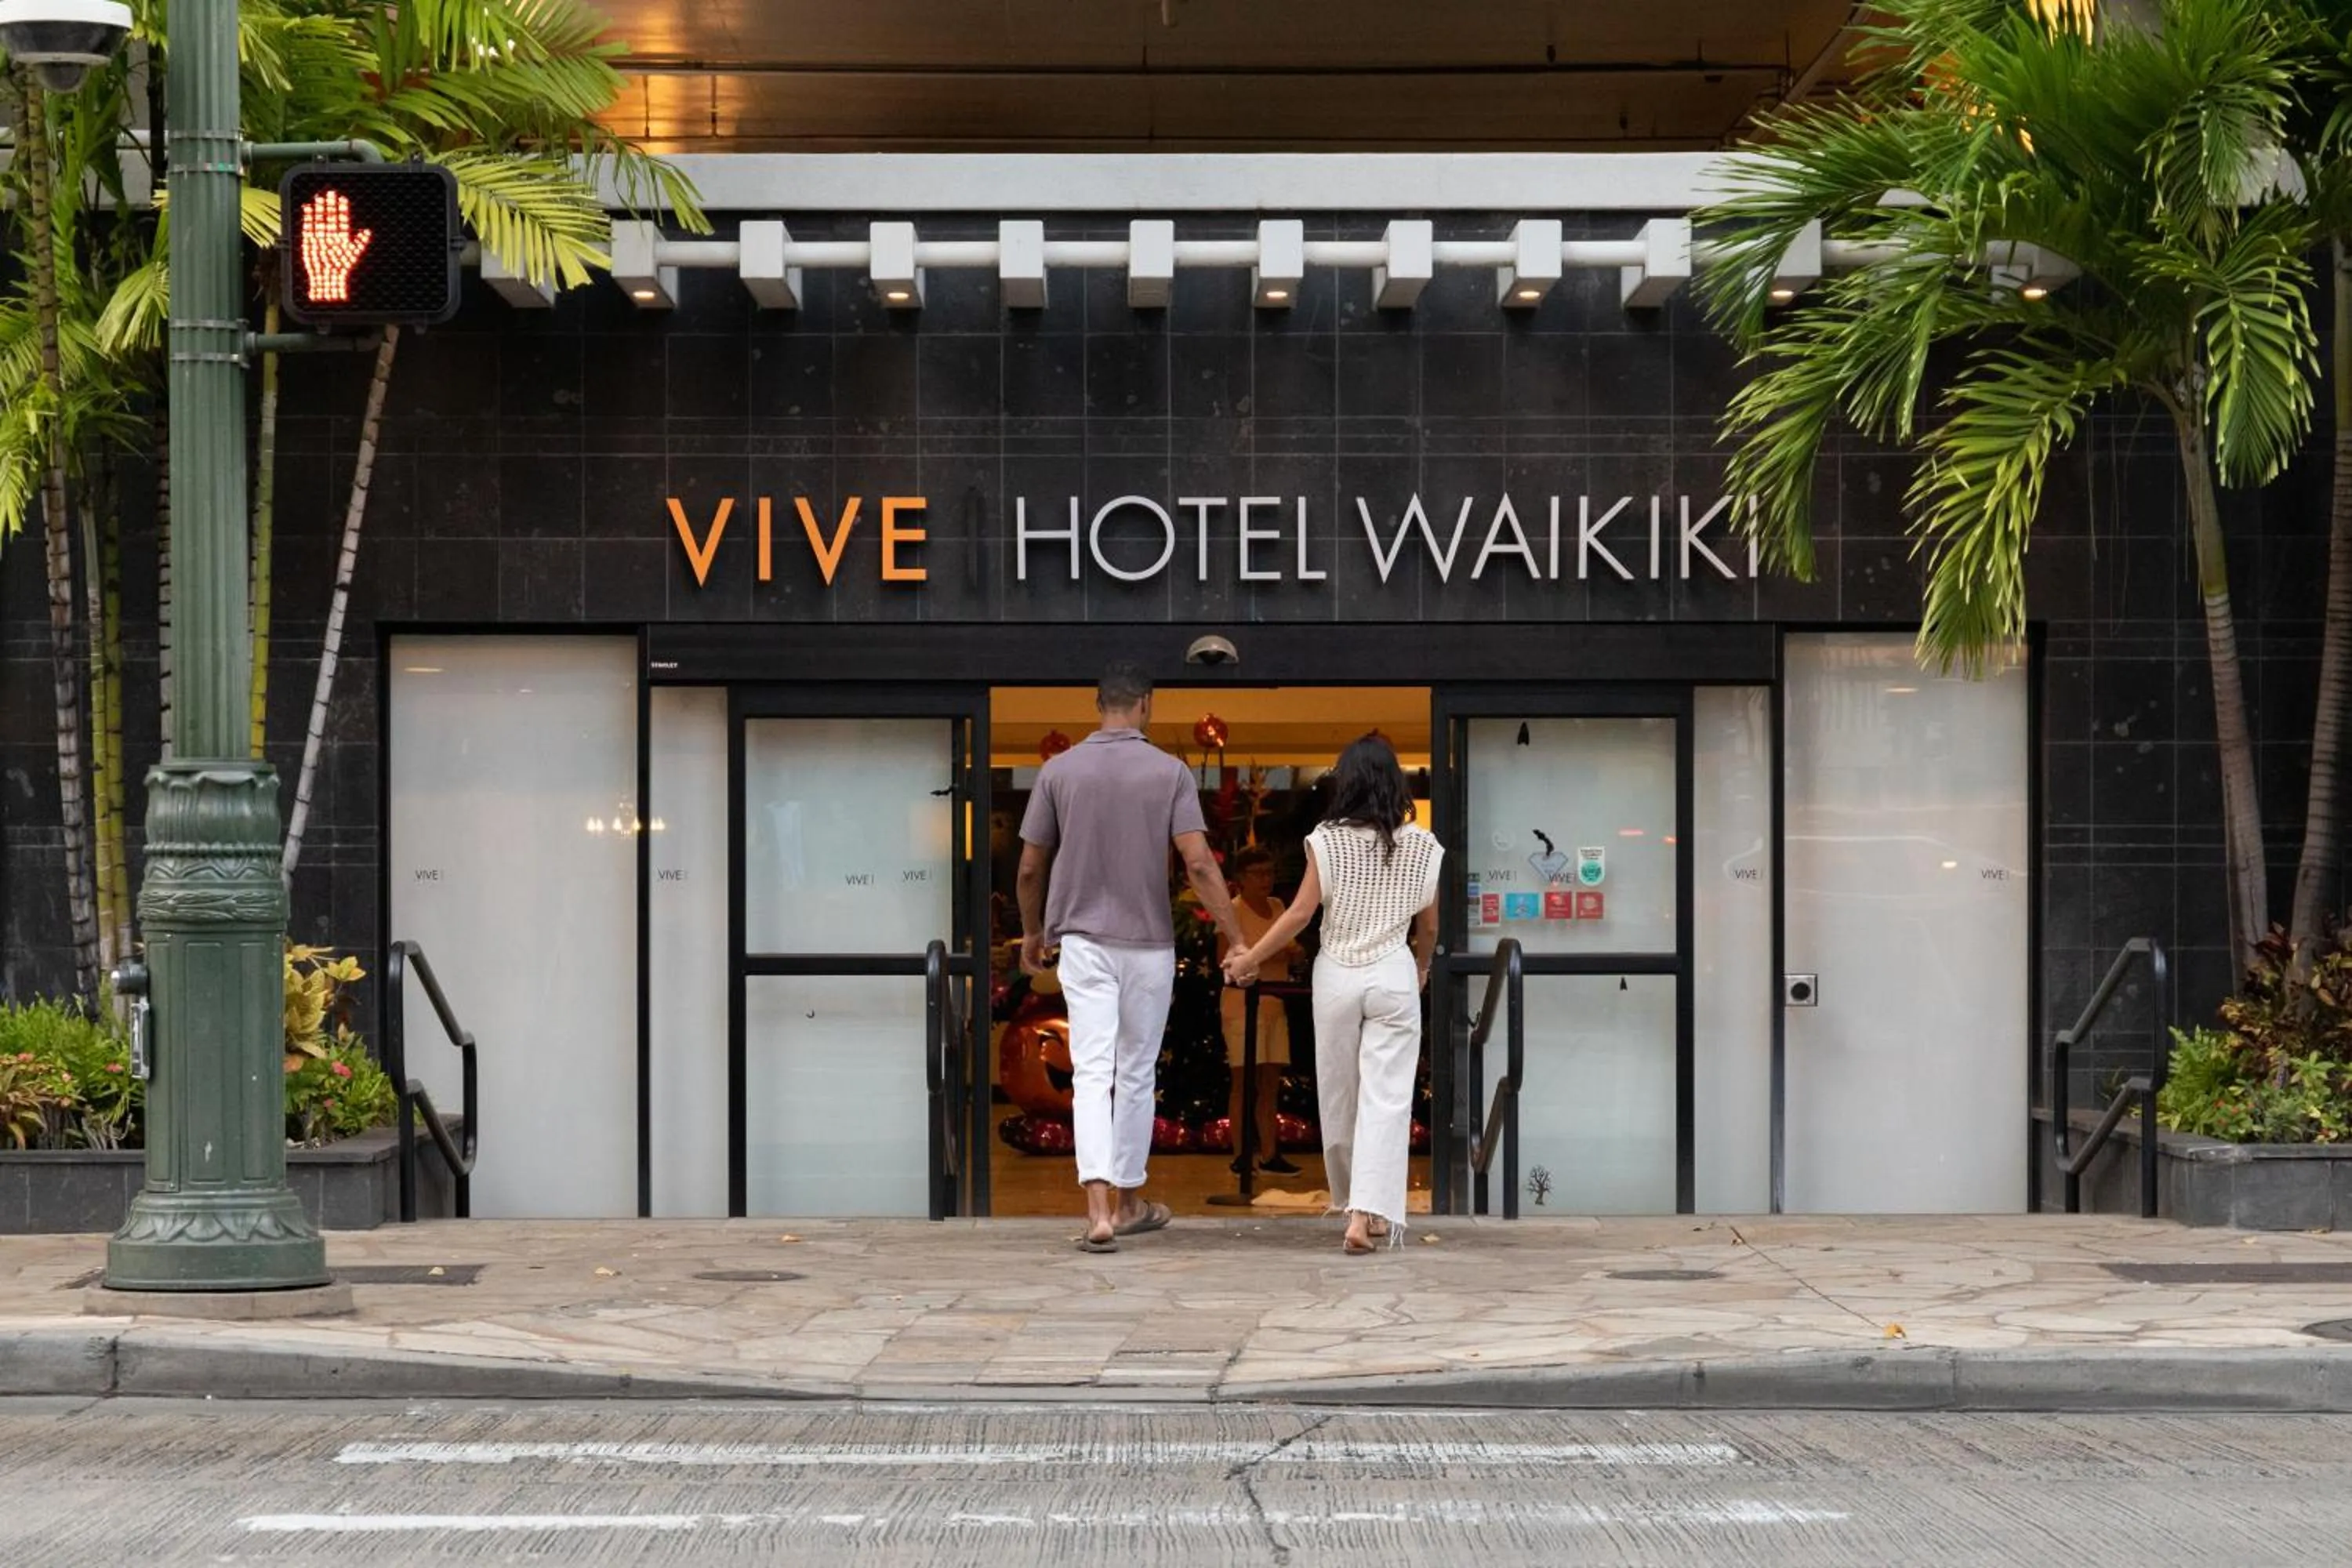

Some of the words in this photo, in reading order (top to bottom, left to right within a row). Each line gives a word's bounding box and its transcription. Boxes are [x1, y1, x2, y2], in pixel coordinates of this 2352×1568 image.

[668, 498, 926, 582] VIVE
[1016, 494, 1327, 581] HOTEL
[1356, 492, 1759, 583] WAIKIKI
[416, 870, 437, 881] VIVE
[659, 870, 681, 880] VIVE
[845, 874, 868, 885] VIVE
[903, 869, 926, 881] VIVE
[1489, 870, 1511, 880] VIVE
[1548, 872, 1573, 884] VIVE
[1734, 869, 1757, 880] VIVE
[1981, 869, 2004, 880] VIVE
